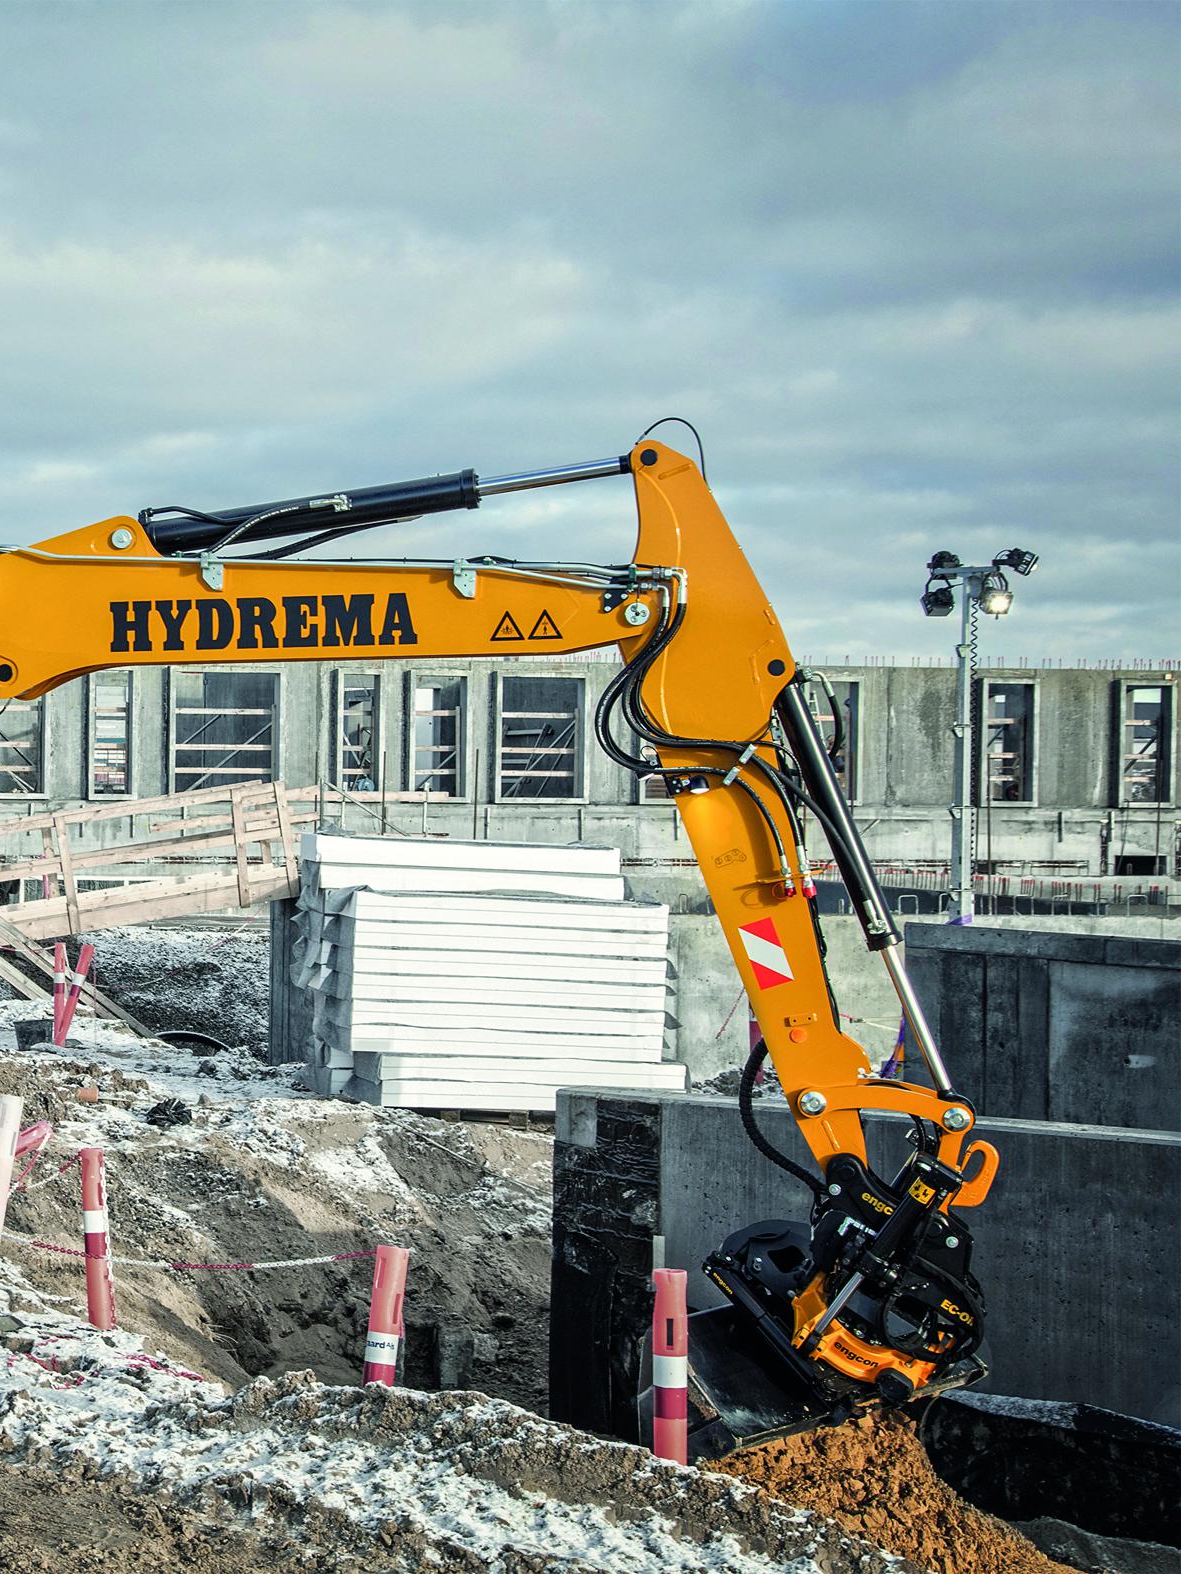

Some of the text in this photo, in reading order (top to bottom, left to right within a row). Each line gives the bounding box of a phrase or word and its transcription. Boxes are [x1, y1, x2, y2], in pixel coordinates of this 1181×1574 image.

[110, 593, 418, 652] HYDREMA
[713, 1272, 734, 1295] engcon
[834, 1341, 880, 1368] engcon
